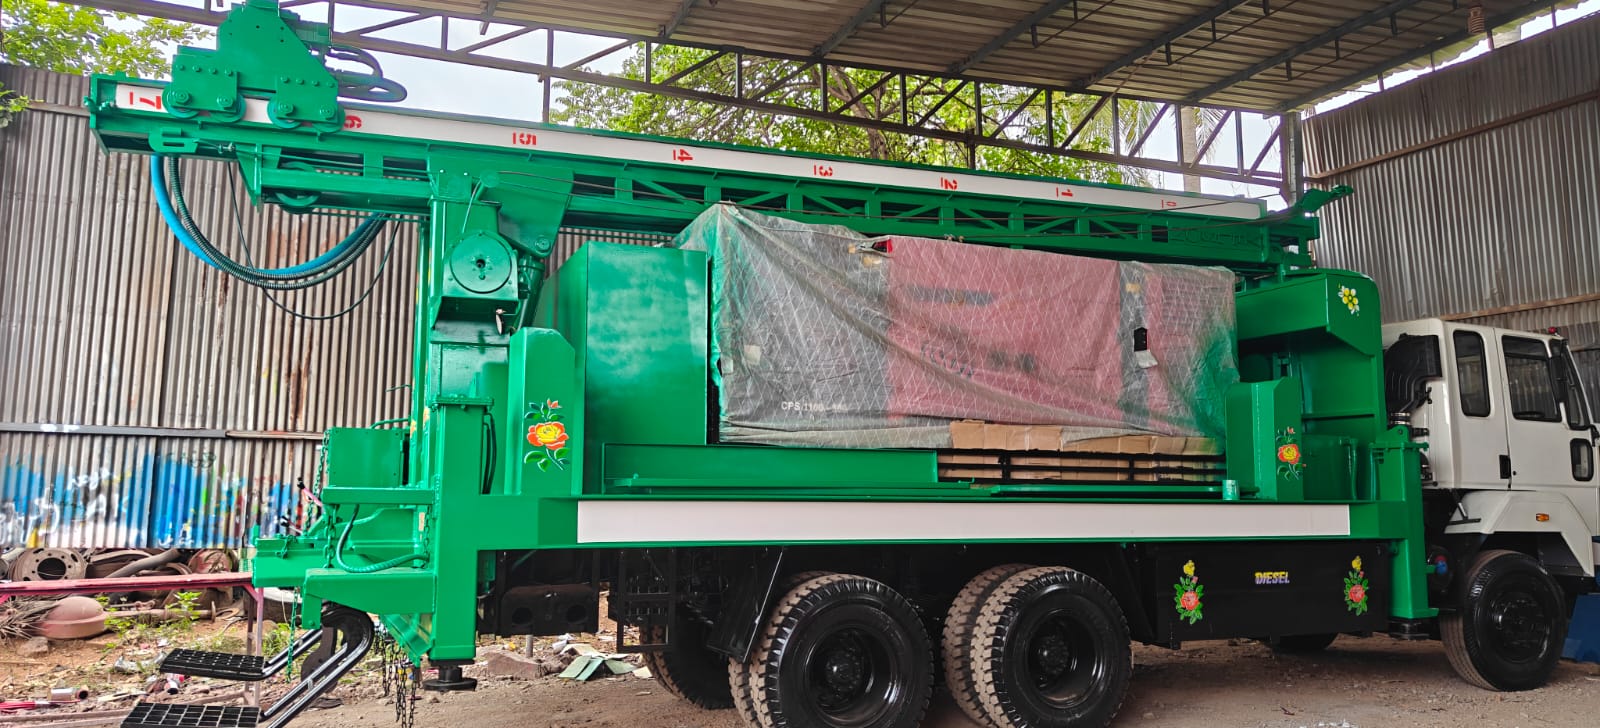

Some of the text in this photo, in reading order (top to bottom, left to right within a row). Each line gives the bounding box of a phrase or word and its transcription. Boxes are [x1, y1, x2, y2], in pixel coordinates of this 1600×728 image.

[518, 132, 538, 146] 5
[677, 148, 694, 162] 4
[818, 165, 833, 177] 3
[781, 401, 800, 411] CPS
[1254, 571, 1290, 585] DIESEL
